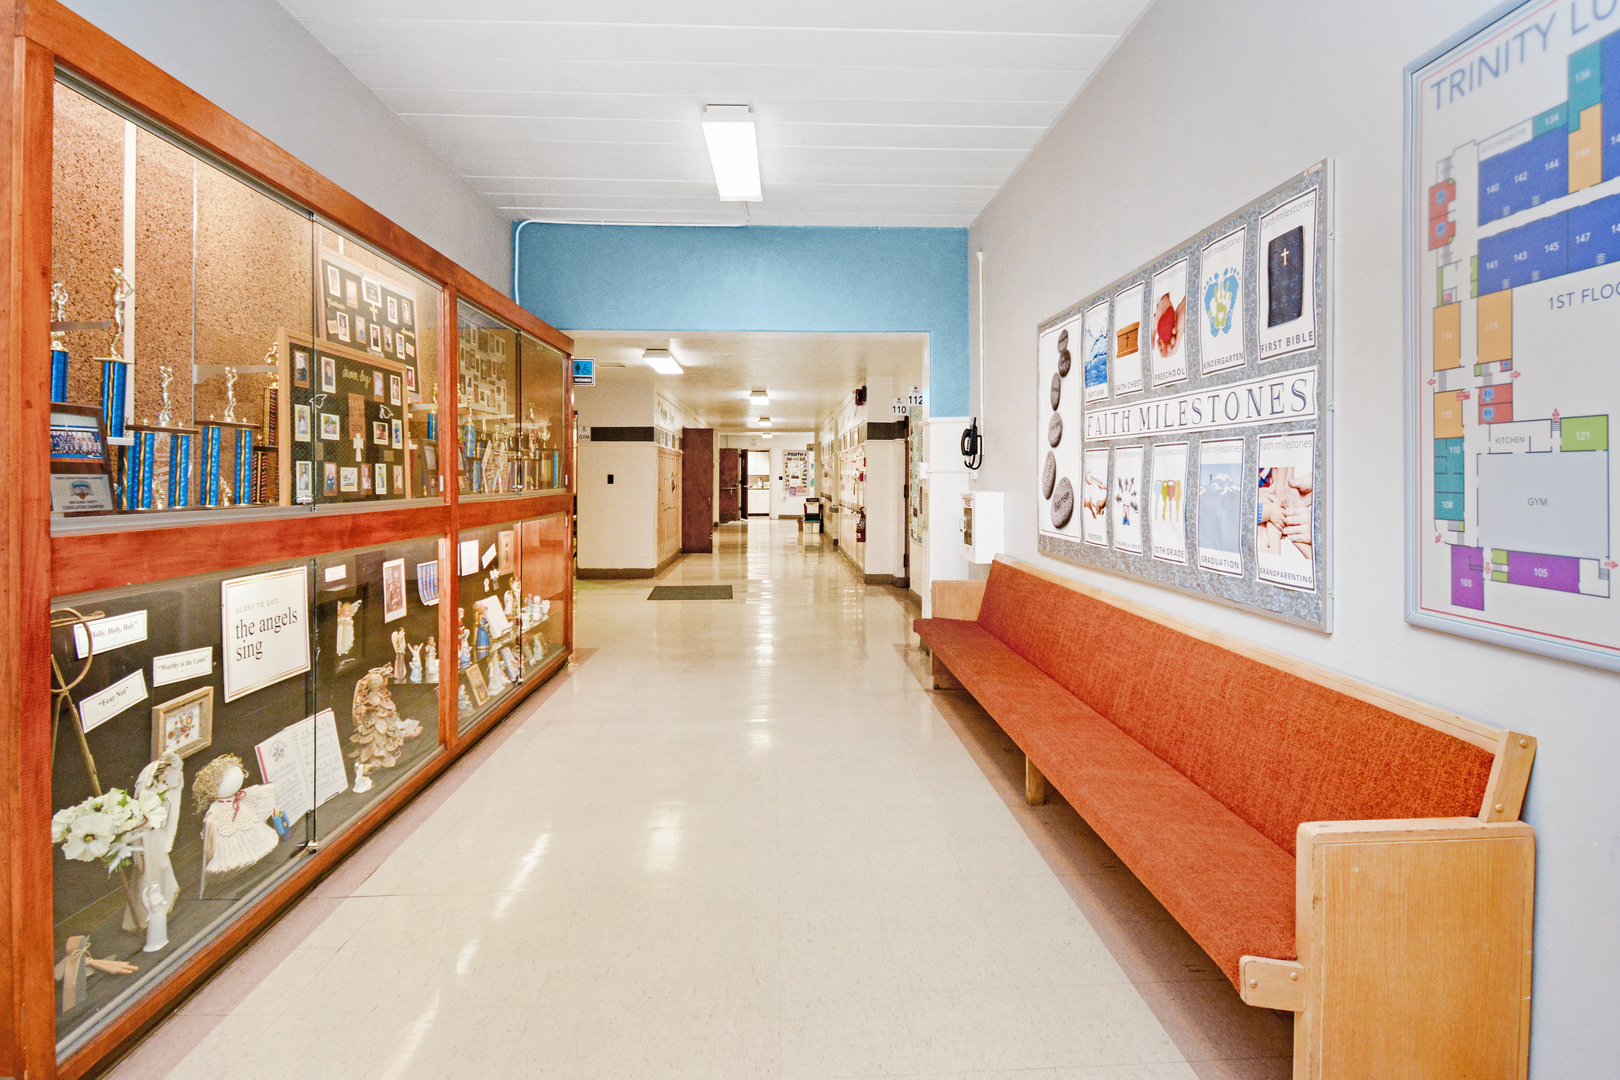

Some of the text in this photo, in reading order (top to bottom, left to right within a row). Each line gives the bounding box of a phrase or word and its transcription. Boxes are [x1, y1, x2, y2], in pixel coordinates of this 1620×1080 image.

[1430, 11, 1556, 110] TRINITY
[1545, 113, 1559, 126] 134
[1482, 127, 1527, 152] KITCHENETTE
[1545, 159, 1559, 171] 144
[1514, 171, 1528, 184] 142
[1486, 183, 1499, 194] 140
[1262, 196, 1315, 230] faith milestones
[1576, 232, 1591, 244] 147
[1544, 242, 1560, 253] 145
[1514, 251, 1528, 262] 143
[1486, 260, 1498, 270] 141
[1548, 292, 1576, 310] 1ST
[1486, 322, 1498, 331] 115
[1261, 331, 1314, 354] FIRST BIBLE
[1204, 352, 1244, 368] KINDERGARTEN
[1155, 368, 1186, 380] PRESCHOOL
[1128, 380, 1142, 388] CHEST
[908, 395, 923, 404] 112
[892, 405, 907, 414] 110
[1087, 378, 1308, 437] FAITH MILESTONES
[1442, 410, 1453, 418] 112
[1576, 432, 1590, 440] 121
[1214, 444, 1242, 453] milestones
[1261, 438, 1312, 450] faith milestones
[1449, 446, 1461, 454] 110
[1442, 500, 1454, 509] 108
[1528, 498, 1548, 506] GYM
[1154, 546, 1184, 558] 10TH GRADE
[1202, 555, 1240, 570] GRADUATION
[1260, 567, 1312, 584] GRANDPARENTING
[1534, 568, 1548, 578] 105
[1460, 579, 1472, 588] 103
[235, 604, 254, 614] GLORY
[266, 598, 278, 606] GOD
[236, 606, 298, 640] the angels
[108, 626, 122, 636] Holy,
[236, 640, 263, 662] sing
